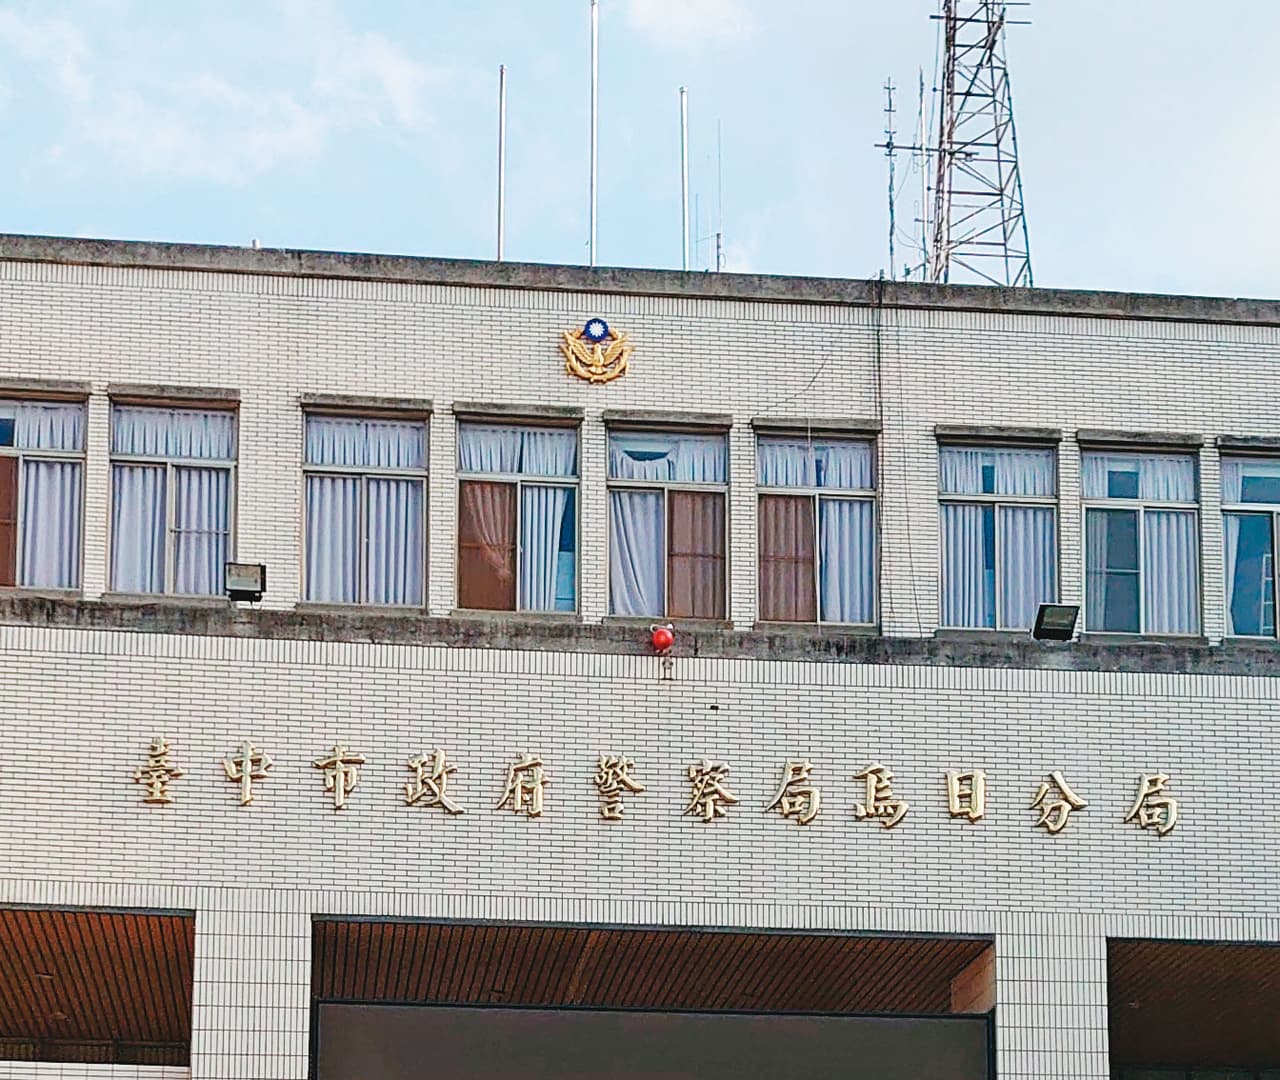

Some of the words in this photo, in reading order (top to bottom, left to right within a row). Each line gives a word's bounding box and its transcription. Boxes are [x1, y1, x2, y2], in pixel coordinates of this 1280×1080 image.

[133, 736, 1178, 836] 臺中市政府警察局烏日分局
